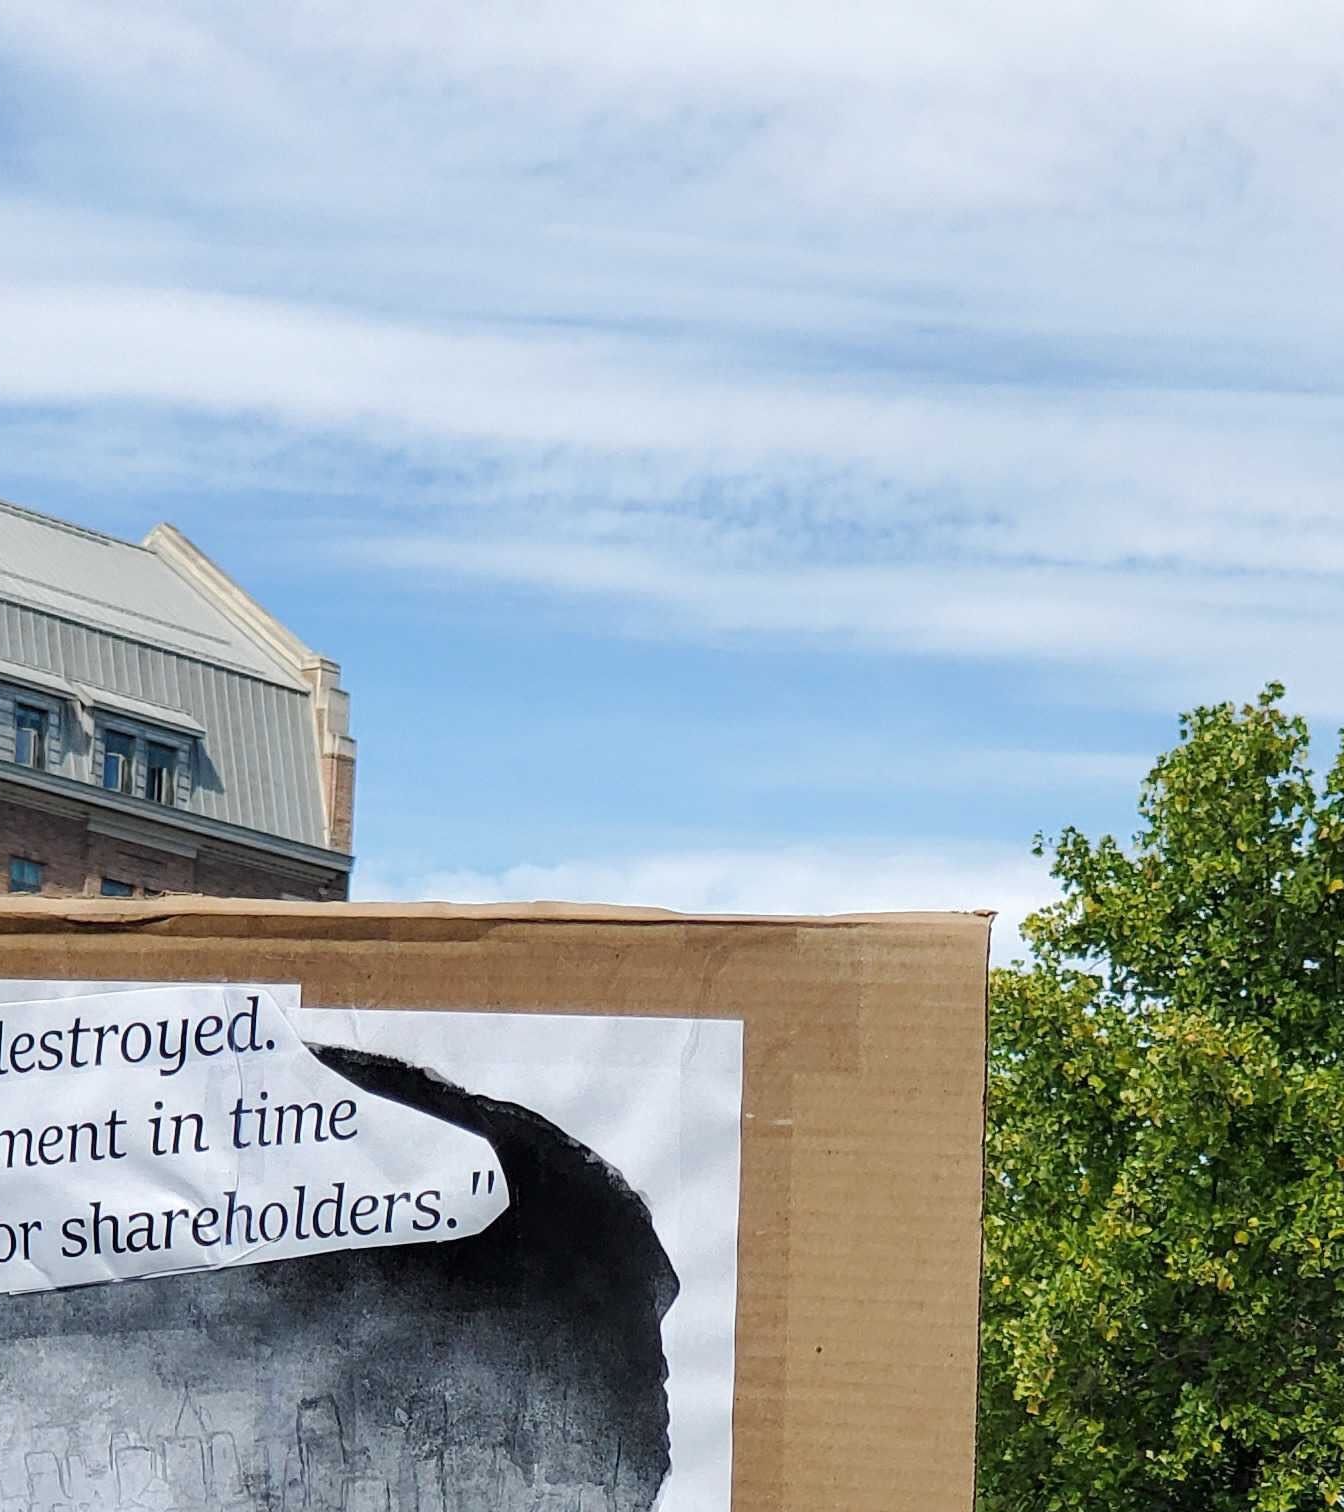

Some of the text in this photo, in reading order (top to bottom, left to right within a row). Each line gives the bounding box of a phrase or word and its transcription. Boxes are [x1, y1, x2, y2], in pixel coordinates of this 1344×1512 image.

[150, 1101, 210, 1158] in
[230, 1091, 359, 1150] time
[59, 1168, 496, 1260] shareholders."
